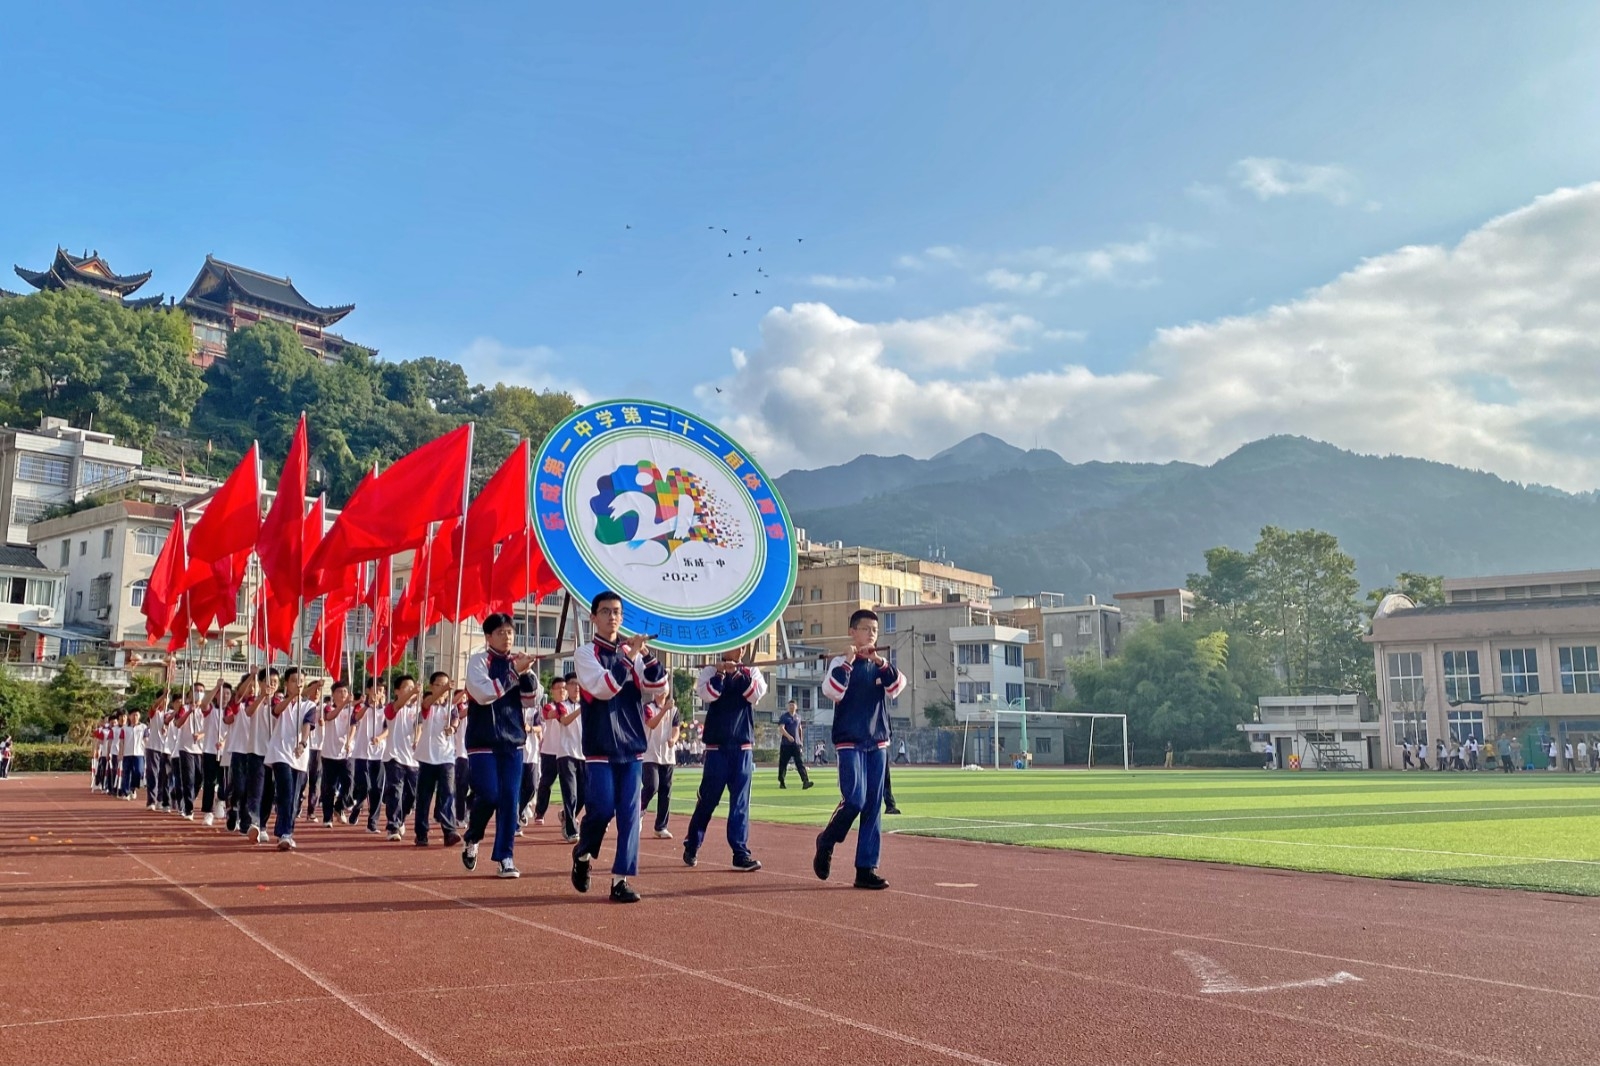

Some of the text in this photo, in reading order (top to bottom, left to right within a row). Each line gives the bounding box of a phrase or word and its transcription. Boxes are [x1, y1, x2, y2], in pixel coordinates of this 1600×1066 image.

[683, 557, 726, 568] 乐成一中
[661, 572, 699, 582] 2022
